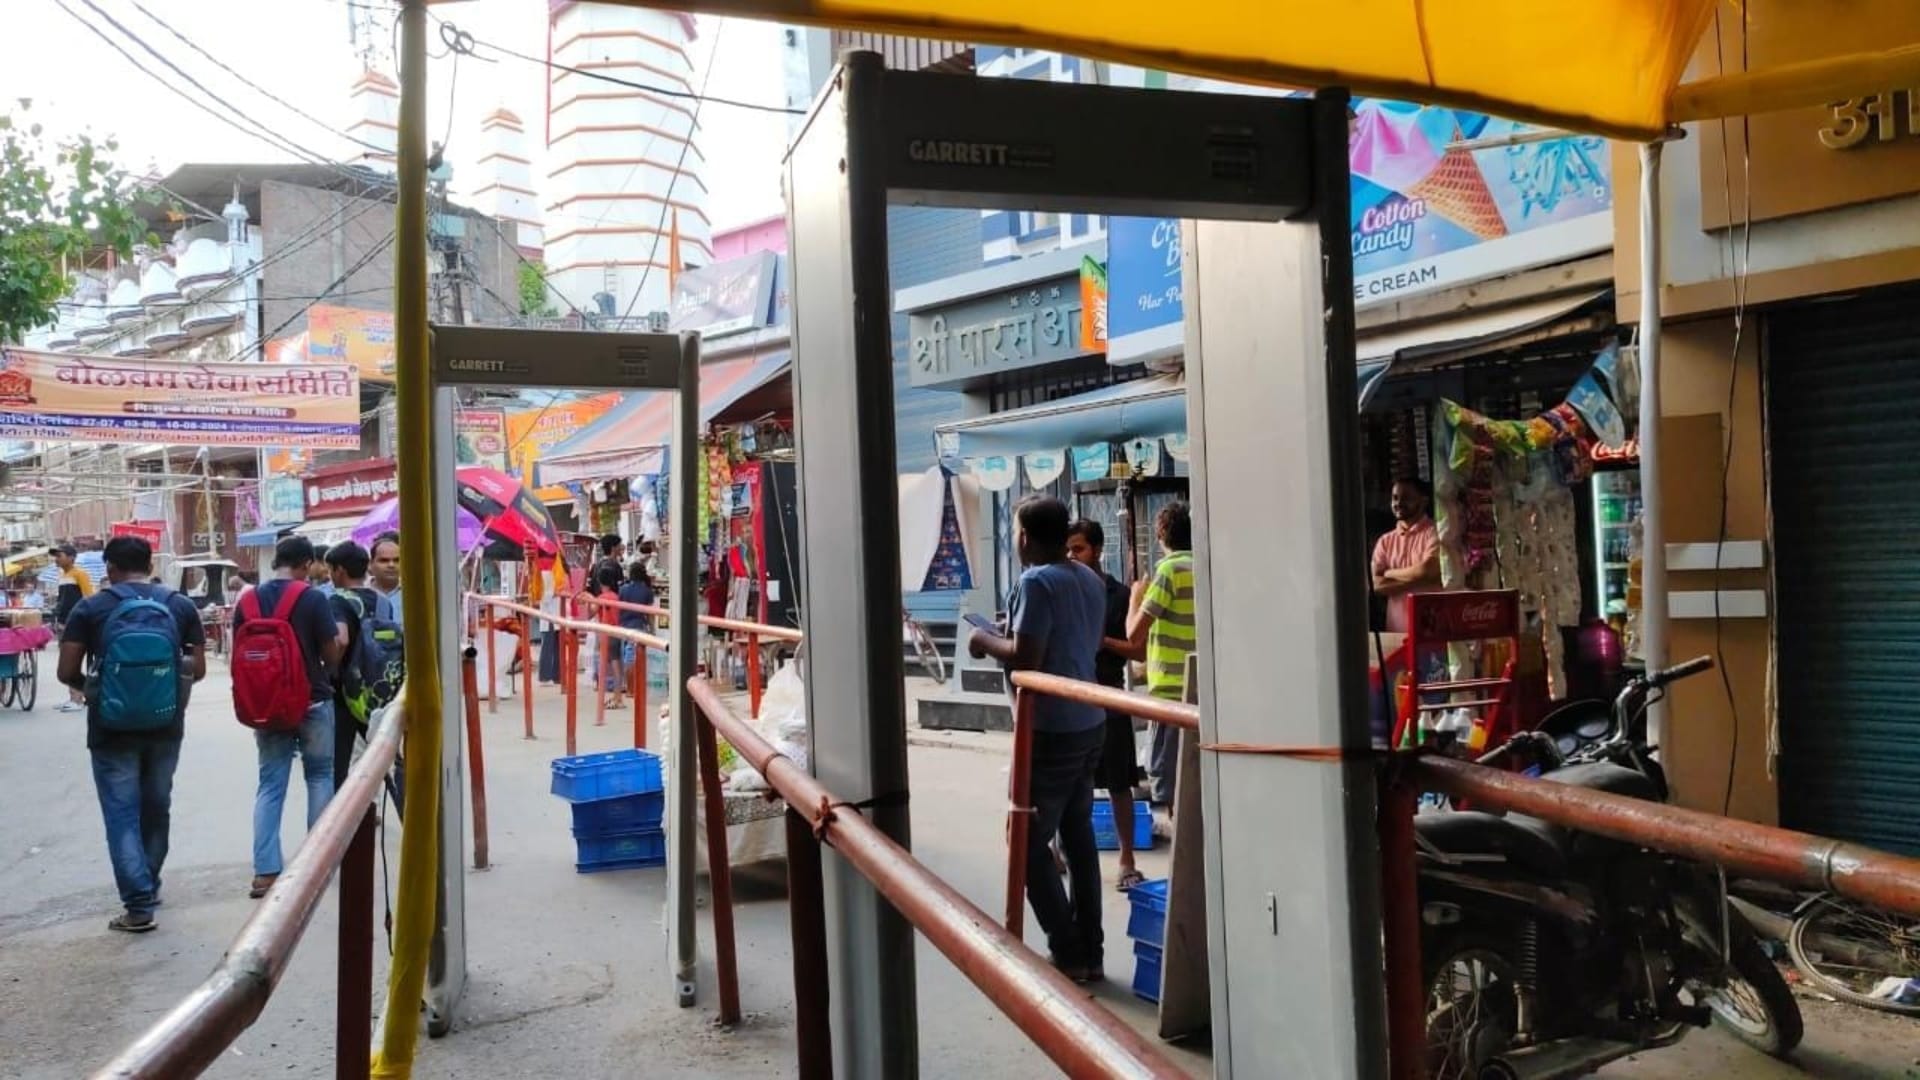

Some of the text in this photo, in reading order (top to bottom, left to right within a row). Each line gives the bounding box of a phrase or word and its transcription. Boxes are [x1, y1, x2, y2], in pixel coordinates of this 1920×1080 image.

[910, 140, 1008, 165] GARRETT
[1351, 220, 1413, 257] Candy
[1369, 265, 1437, 295] CREAM
[1138, 293, 1163, 311] Har
[913, 313, 950, 374] श्री
[954, 312, 1036, 367] पारस
[56, 358, 179, 389] बोलबम
[183, 366, 250, 392] सेवा
[255, 369, 352, 396] समिति
[449, 359, 505, 372] GARRETT
